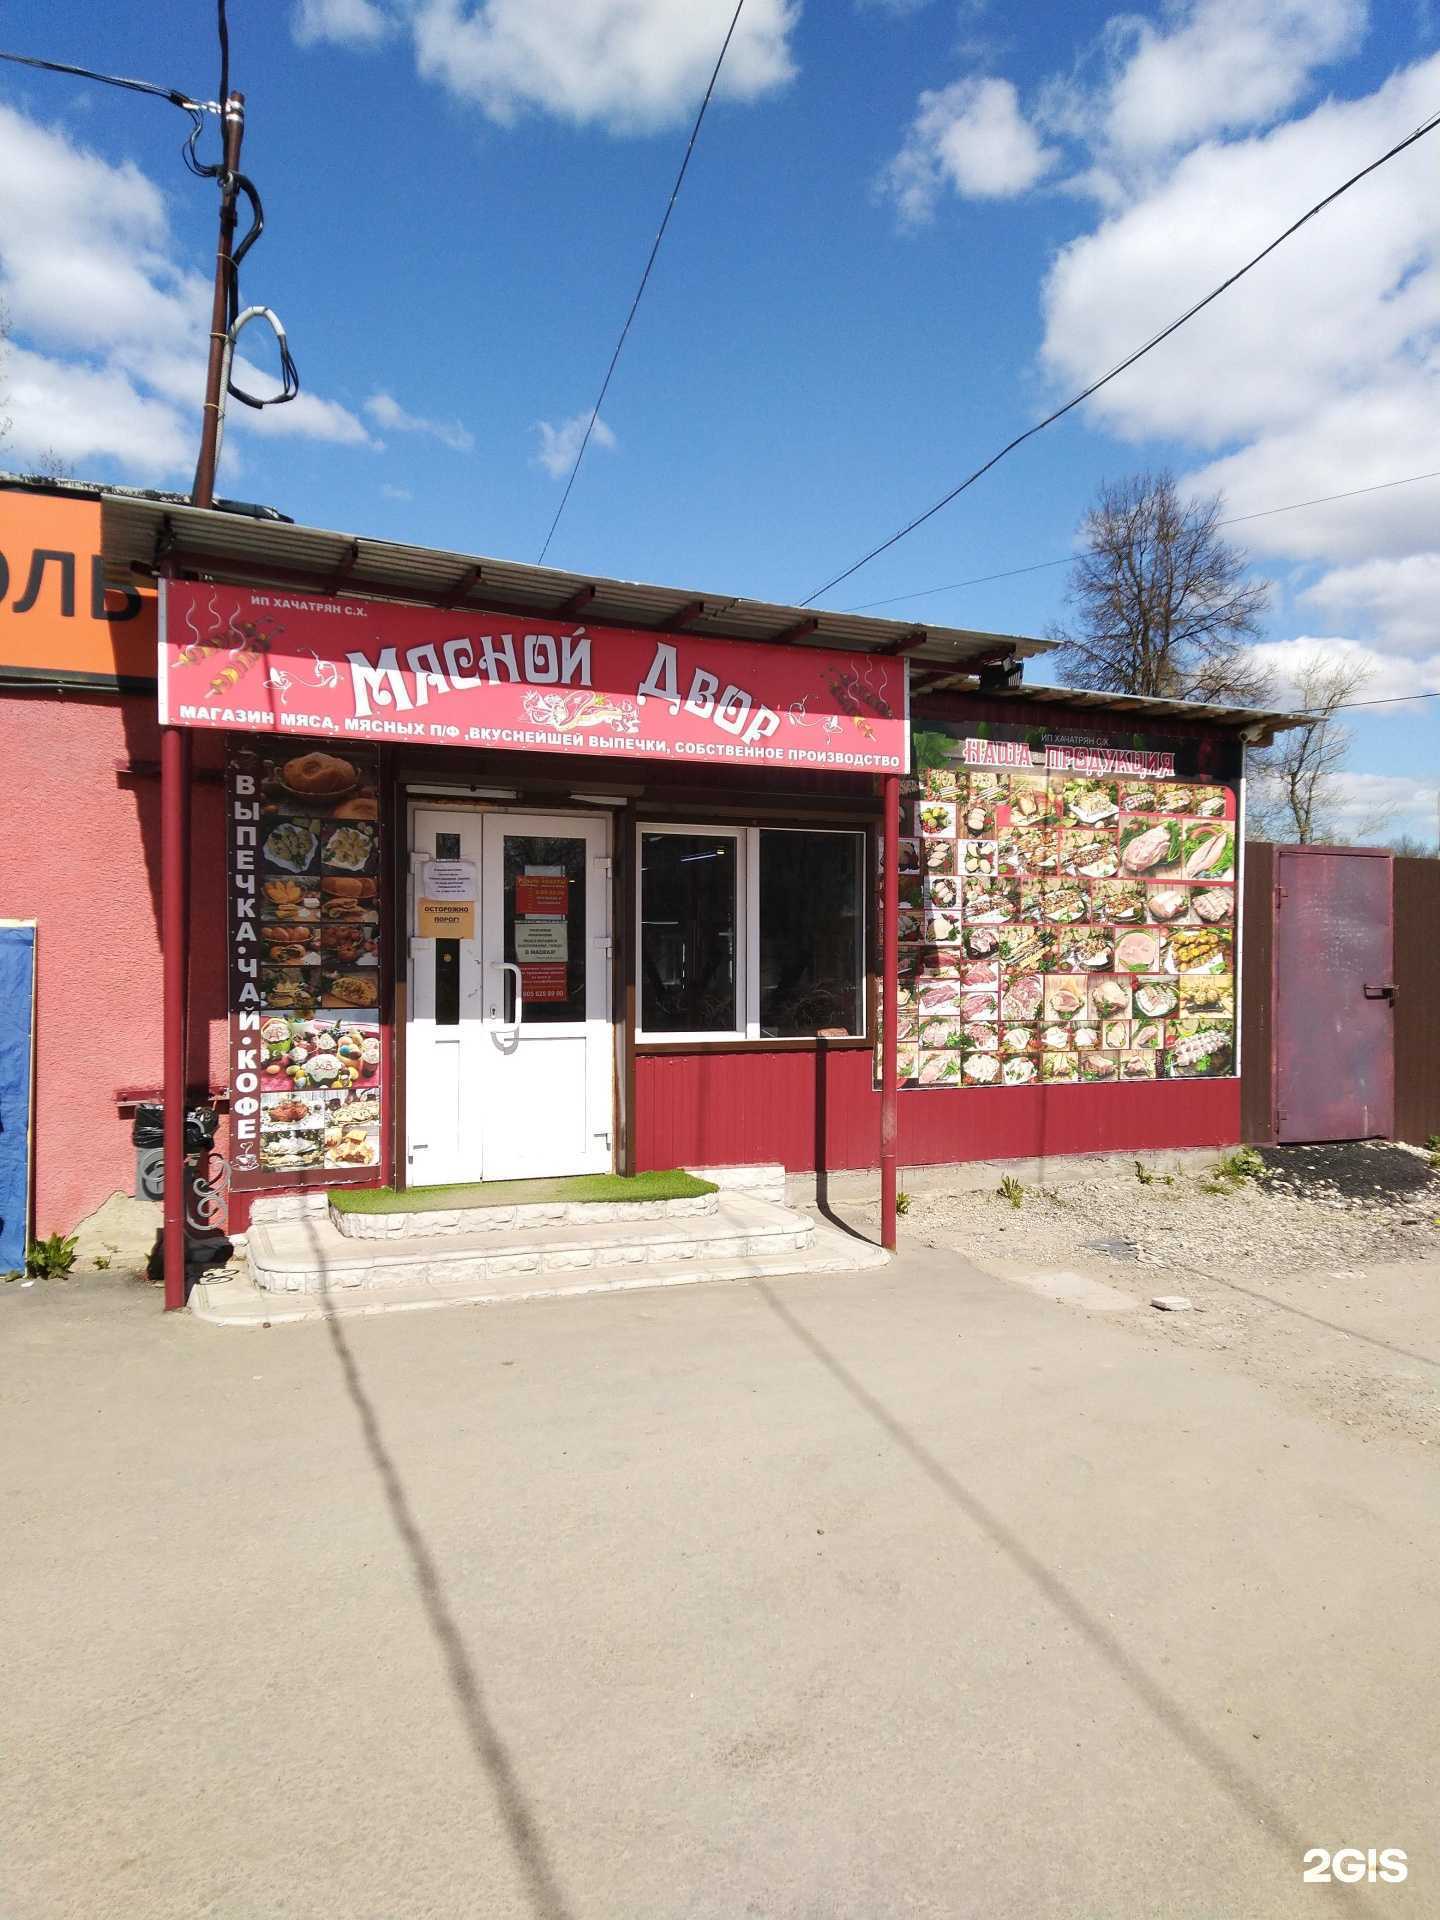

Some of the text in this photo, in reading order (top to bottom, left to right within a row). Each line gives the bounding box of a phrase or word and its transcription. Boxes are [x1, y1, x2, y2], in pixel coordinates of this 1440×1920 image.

[0, 548, 142, 621] ЛЬ
[251, 595, 368, 617] ИП ХАЧАТРЯН С.Х.
[346, 627, 781, 745] МЯСНОЙ ДВОР
[179, 704, 274, 725] МАГАЗИН
[280, 710, 339, 732] МЯСА,
[344, 717, 425, 736] МЯСНЫХ
[430, 724, 460, 739] П/Ф
[588, 735, 671, 753] ВЫПЕЧКИ,
[675, 741, 785, 760] СОБСТВЕННОЕ
[788, 749, 901, 768] ПРОИЗВОДСТВО
[1040, 734, 1053, 743] ИП
[1055, 735, 1095, 746] ХАЧАТРЯН
[963, 738, 1176, 779] НАША ПРОДУКЦИЯ
[424, 905, 469, 914] ОСТОРОЖНО
